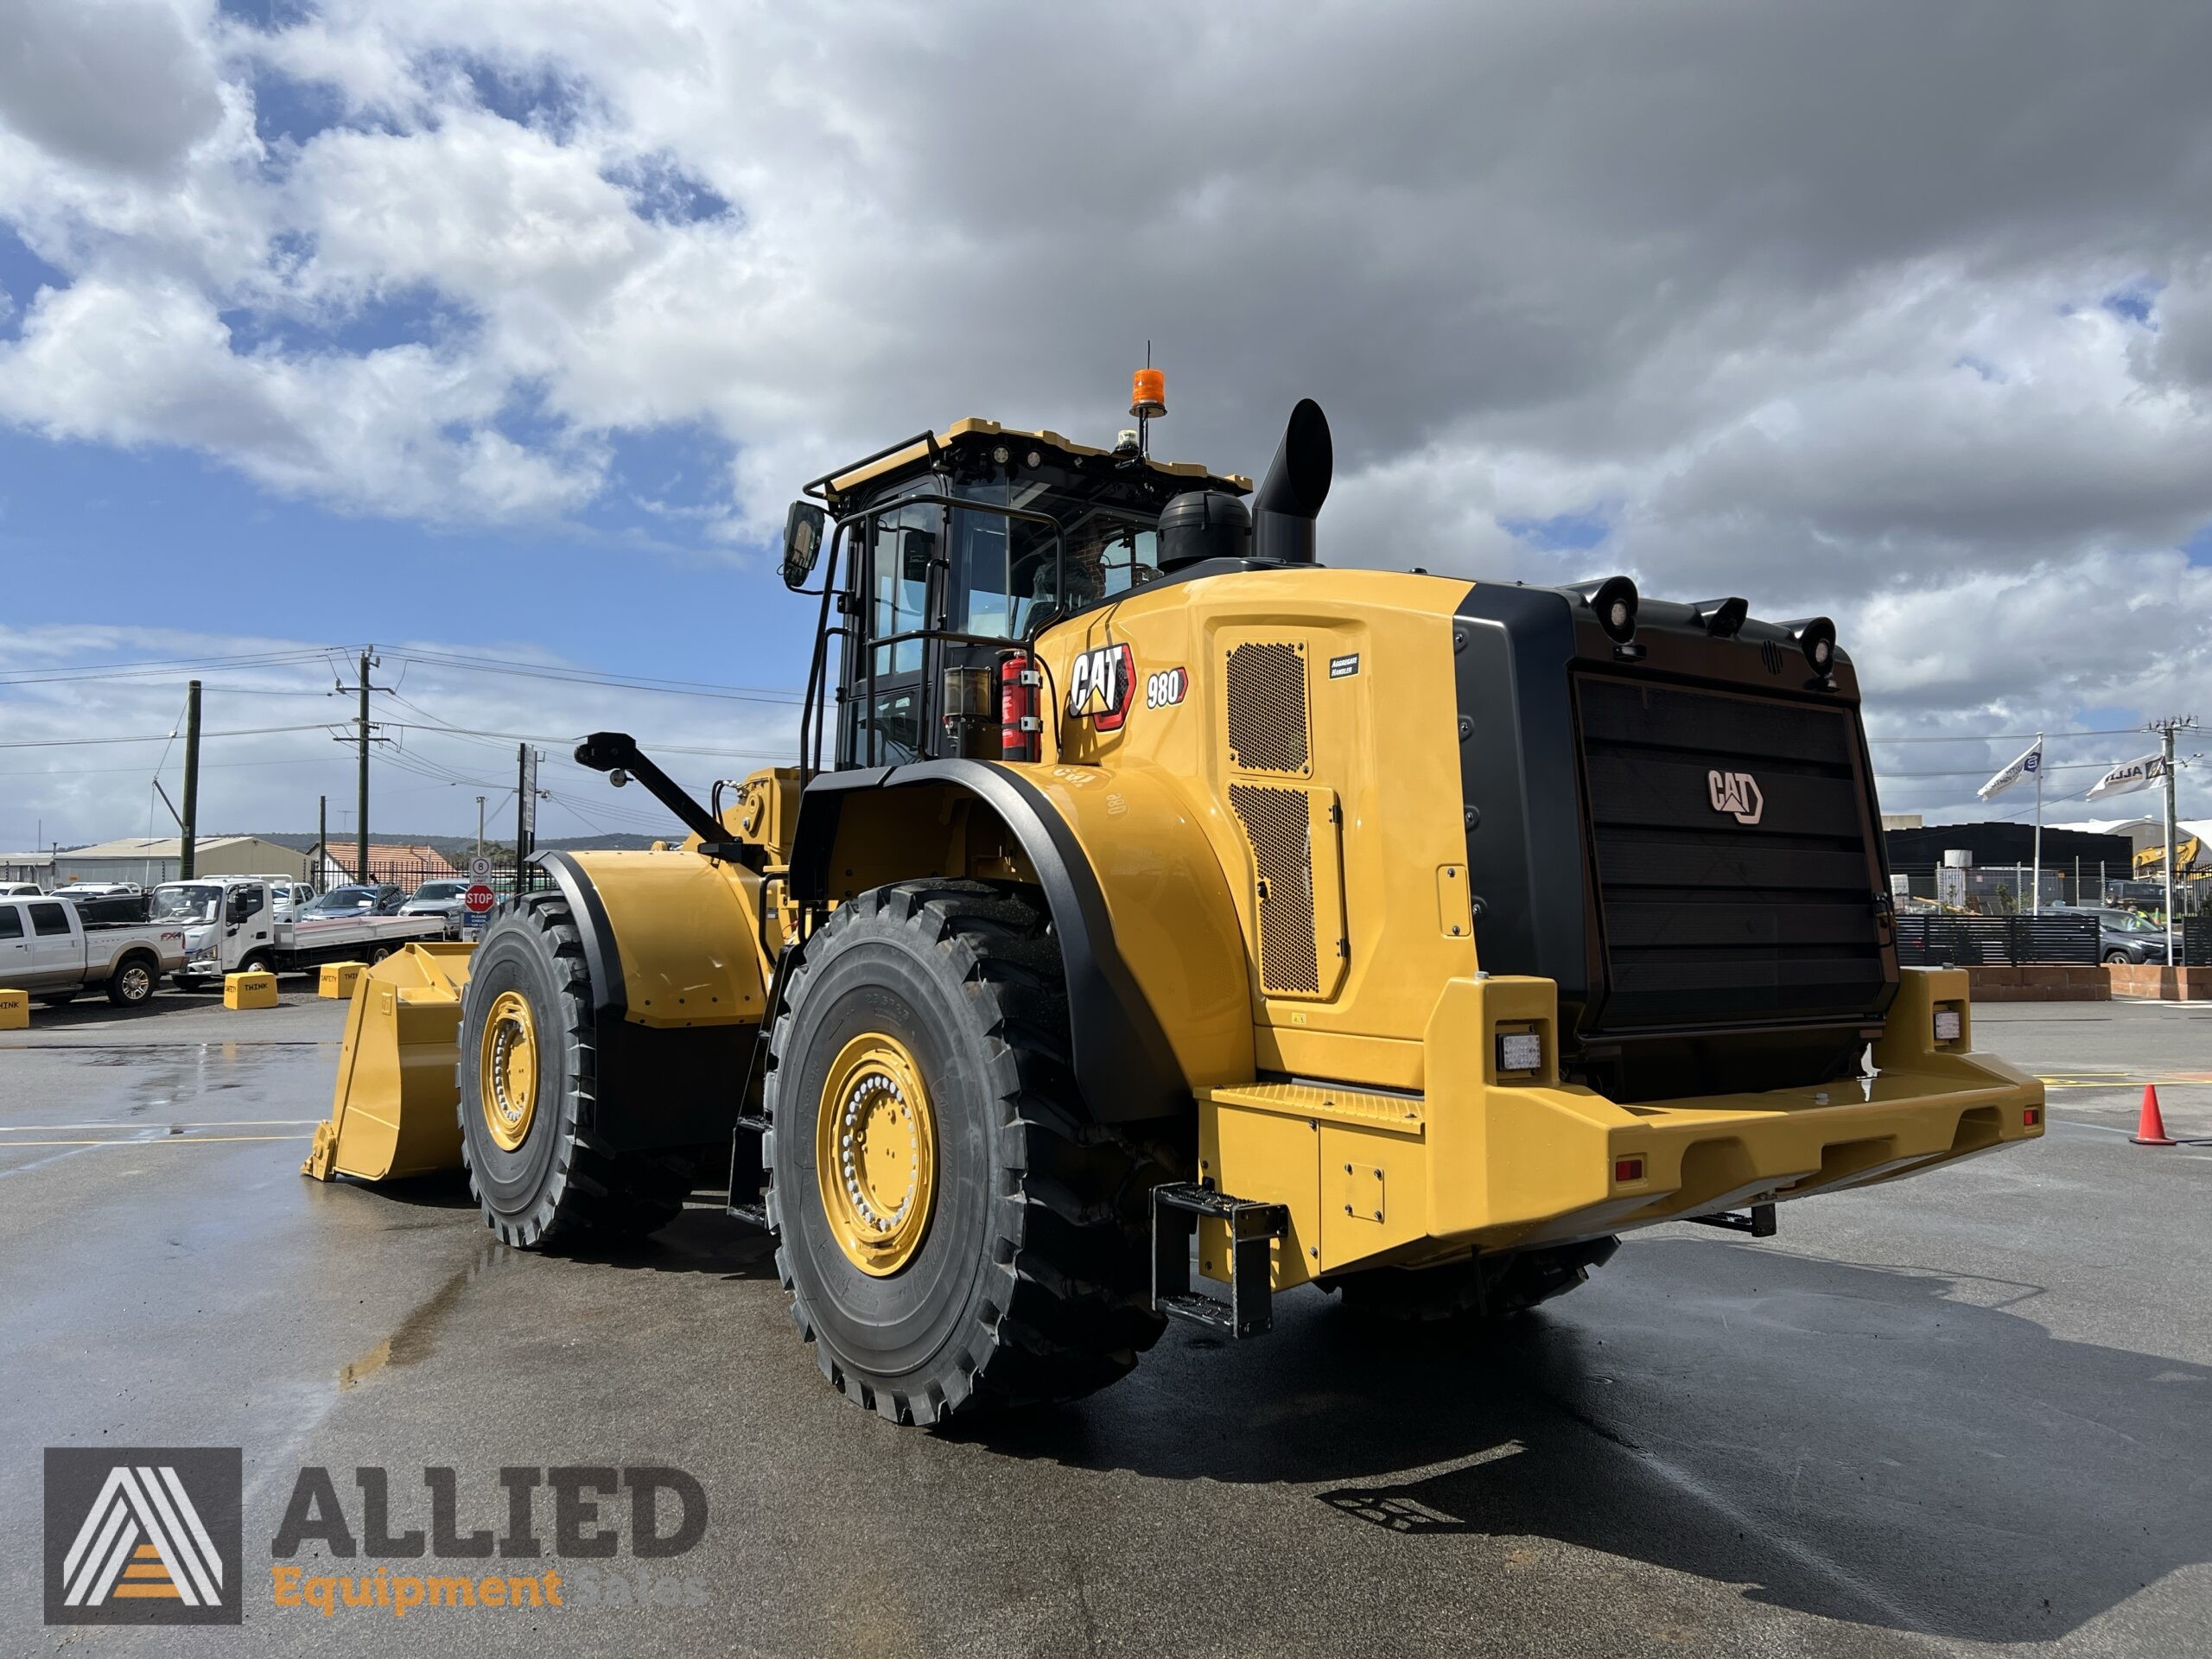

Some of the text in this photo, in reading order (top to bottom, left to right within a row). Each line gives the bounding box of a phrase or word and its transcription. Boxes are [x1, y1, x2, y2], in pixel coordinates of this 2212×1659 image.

[1332, 657, 1357, 668] AGGREGATE
[1332, 667, 1352, 677] HANDLER
[1071, 646, 1123, 711] CAT
[1147, 670, 1179, 709] 980
[1709, 770, 1751, 813] CAT
[478, 862, 484, 871] 8
[467, 893, 493, 904] STOP
[245, 982, 268, 991] THINK
[0, 1001, 19, 1010] HINK
